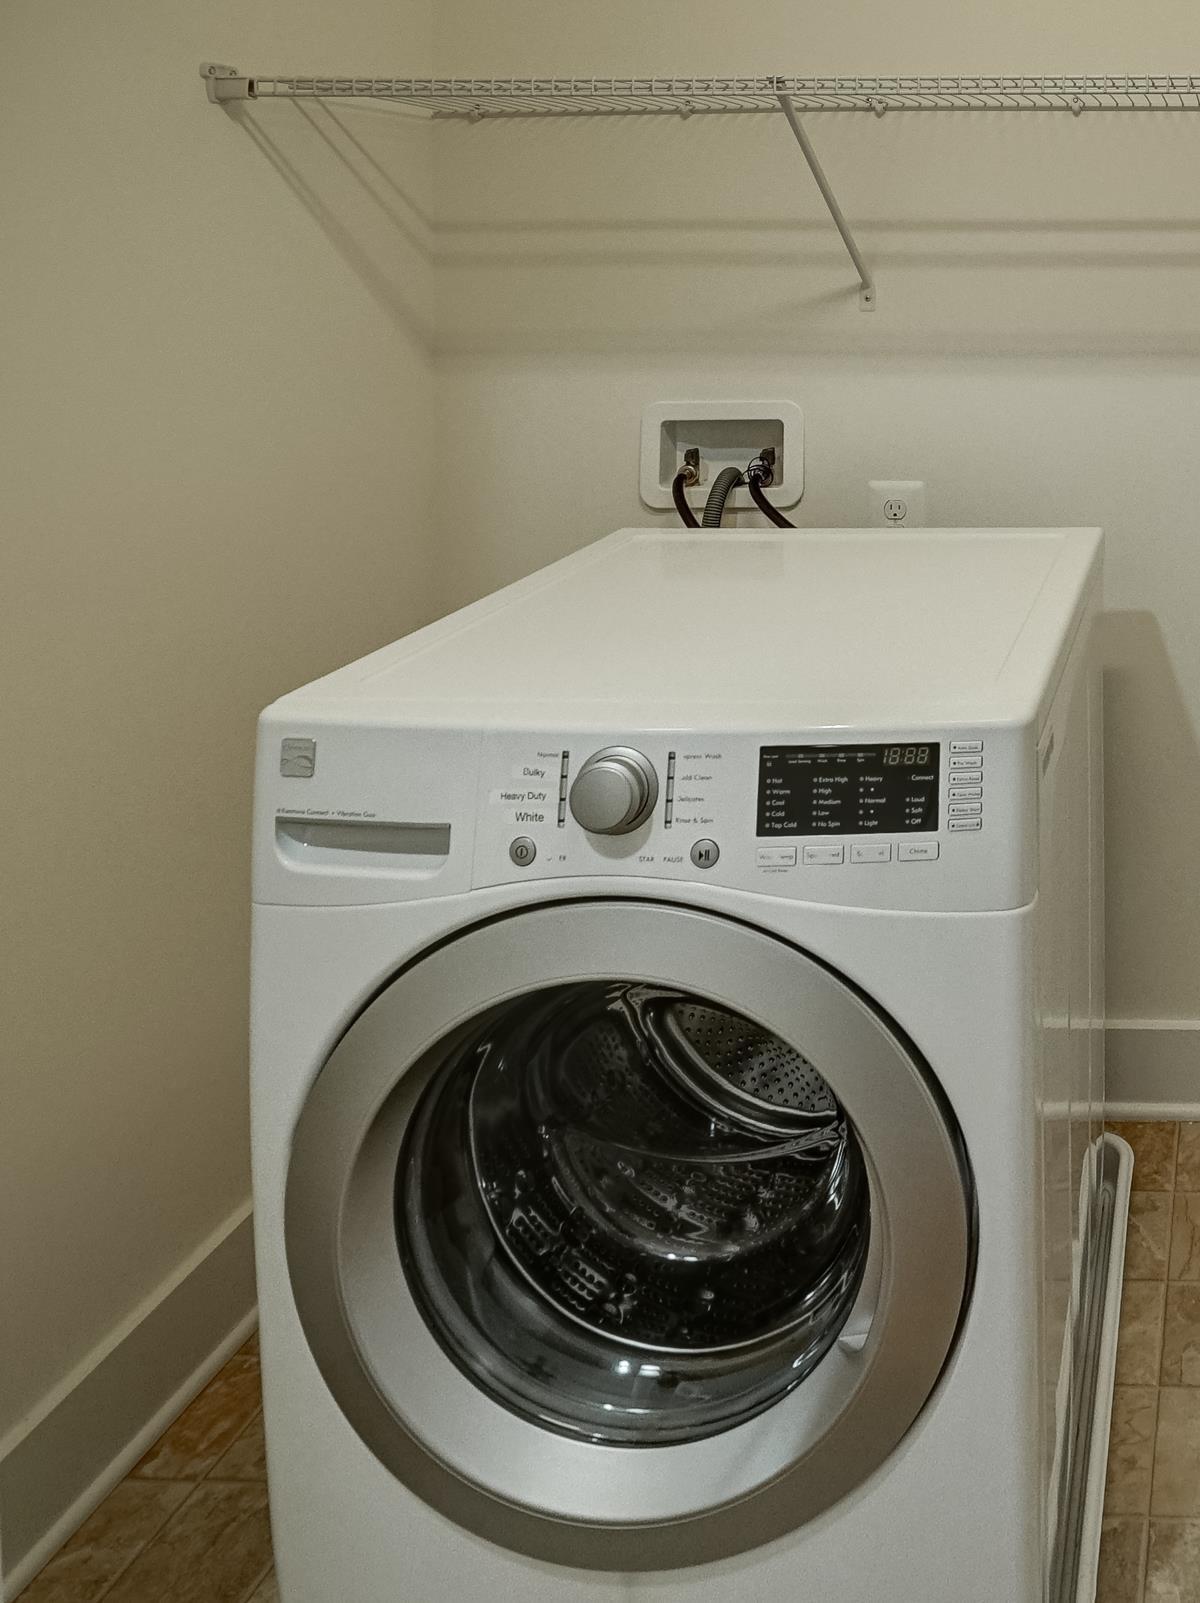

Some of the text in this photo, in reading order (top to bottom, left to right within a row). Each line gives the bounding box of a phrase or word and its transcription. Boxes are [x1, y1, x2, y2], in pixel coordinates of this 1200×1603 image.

[523, 767, 546, 778] Bulky
[835, 776, 849, 784] High
[865, 775, 883, 783] Heavy
[500, 791, 547, 802] Heavy Duty
[515, 812, 545, 822] White
[910, 817, 922, 825] Off
[909, 847, 928, 855] Chime
